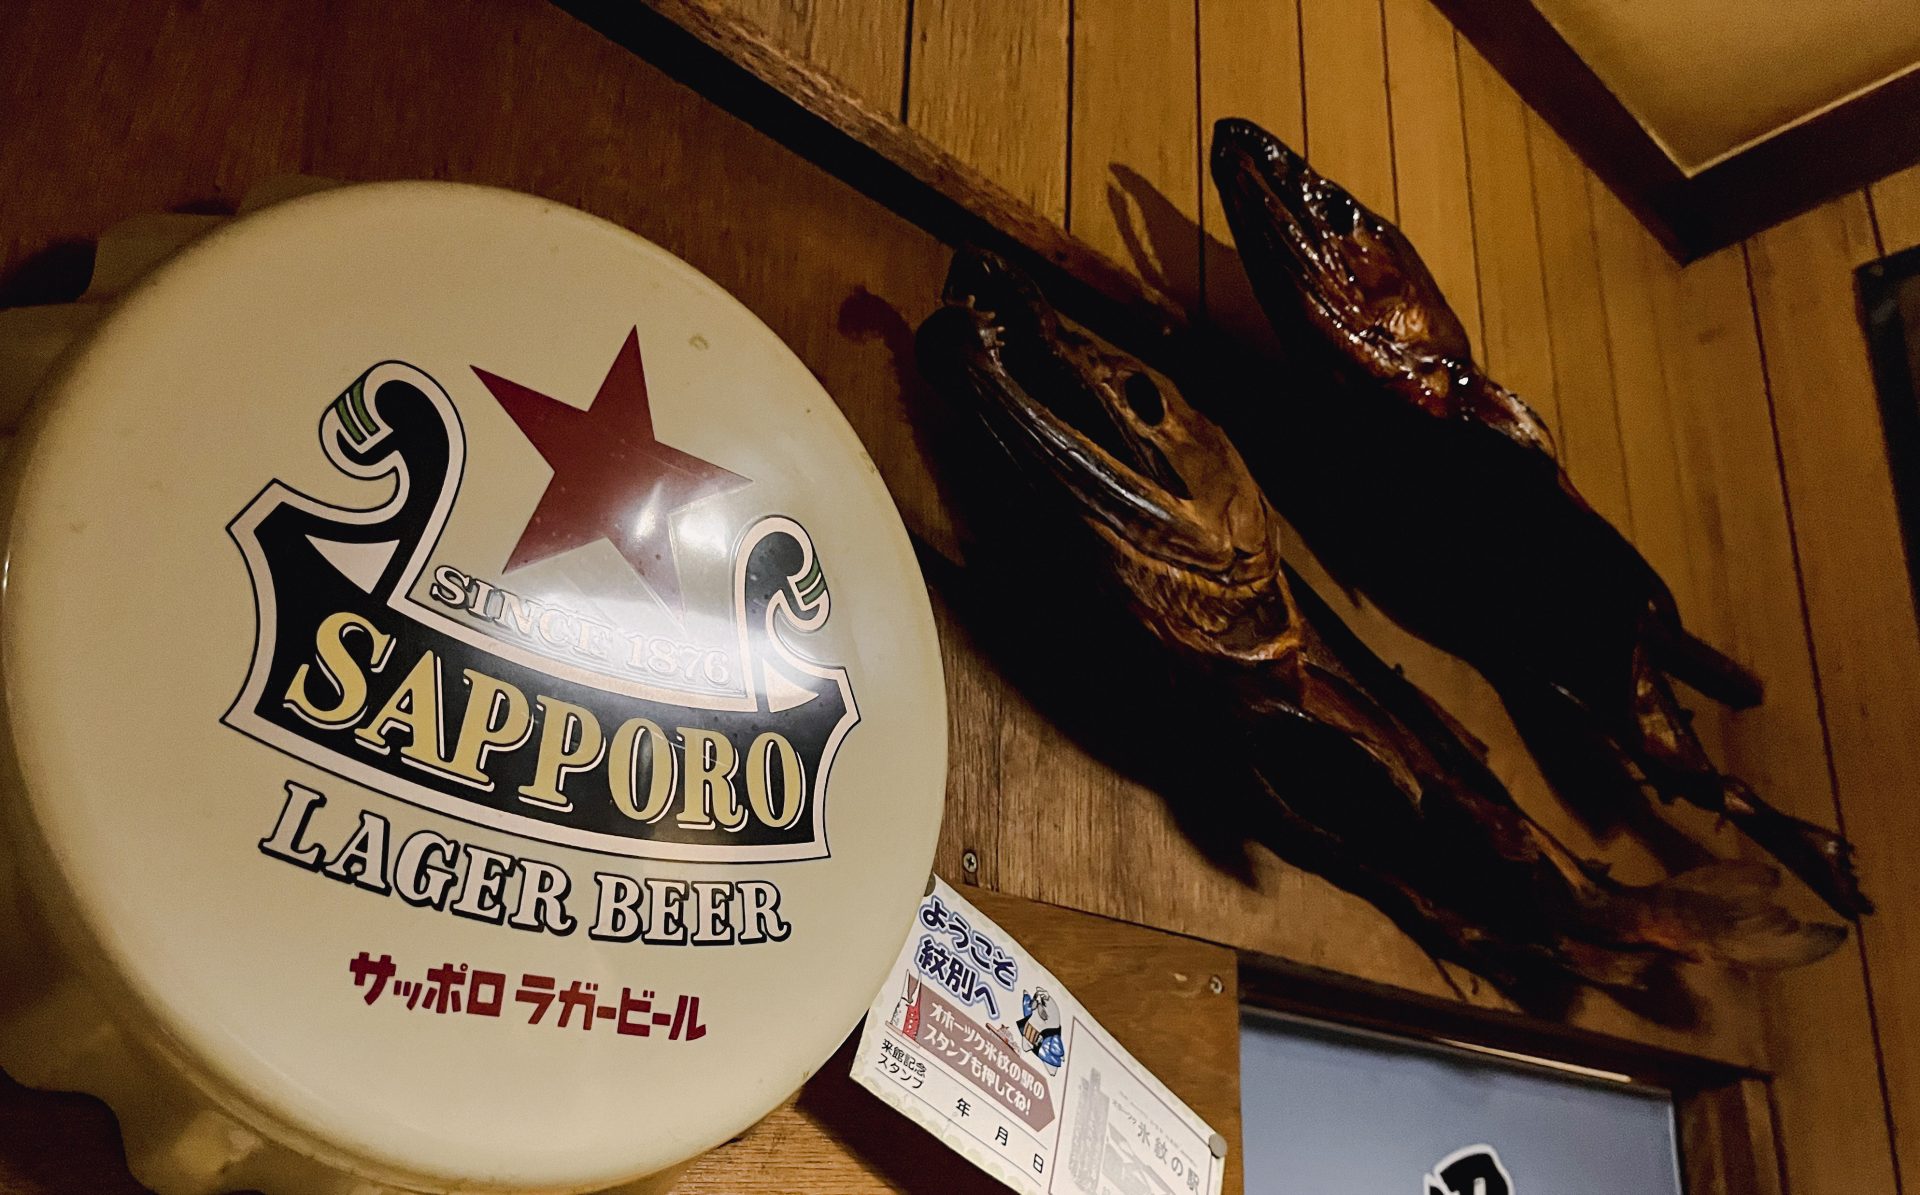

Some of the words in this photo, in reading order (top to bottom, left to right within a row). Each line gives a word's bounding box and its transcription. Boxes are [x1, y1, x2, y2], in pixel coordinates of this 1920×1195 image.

[429, 565, 607, 656] SINCE
[624, 630, 732, 684] 1876
[283, 611, 807, 833] SAPPORO
[259, 779, 577, 935] LAGER
[589, 873, 792, 946] BEER
[916, 936, 998, 1018] 紋別へ
[920, 897, 1018, 990] ようこそ
[349, 951, 504, 1016] サッポロ
[514, 973, 706, 1042] ラガービール
[877, 1053, 924, 1090] スタンプ
[880, 1038, 928, 1078] 来館記念
[929, 1002, 1045, 1100] オホーツク氷紋の駅の
[956, 1098, 972, 1118] 年
[994, 1126, 1009, 1147] 月
[1033, 1153, 1044, 1175] 日
